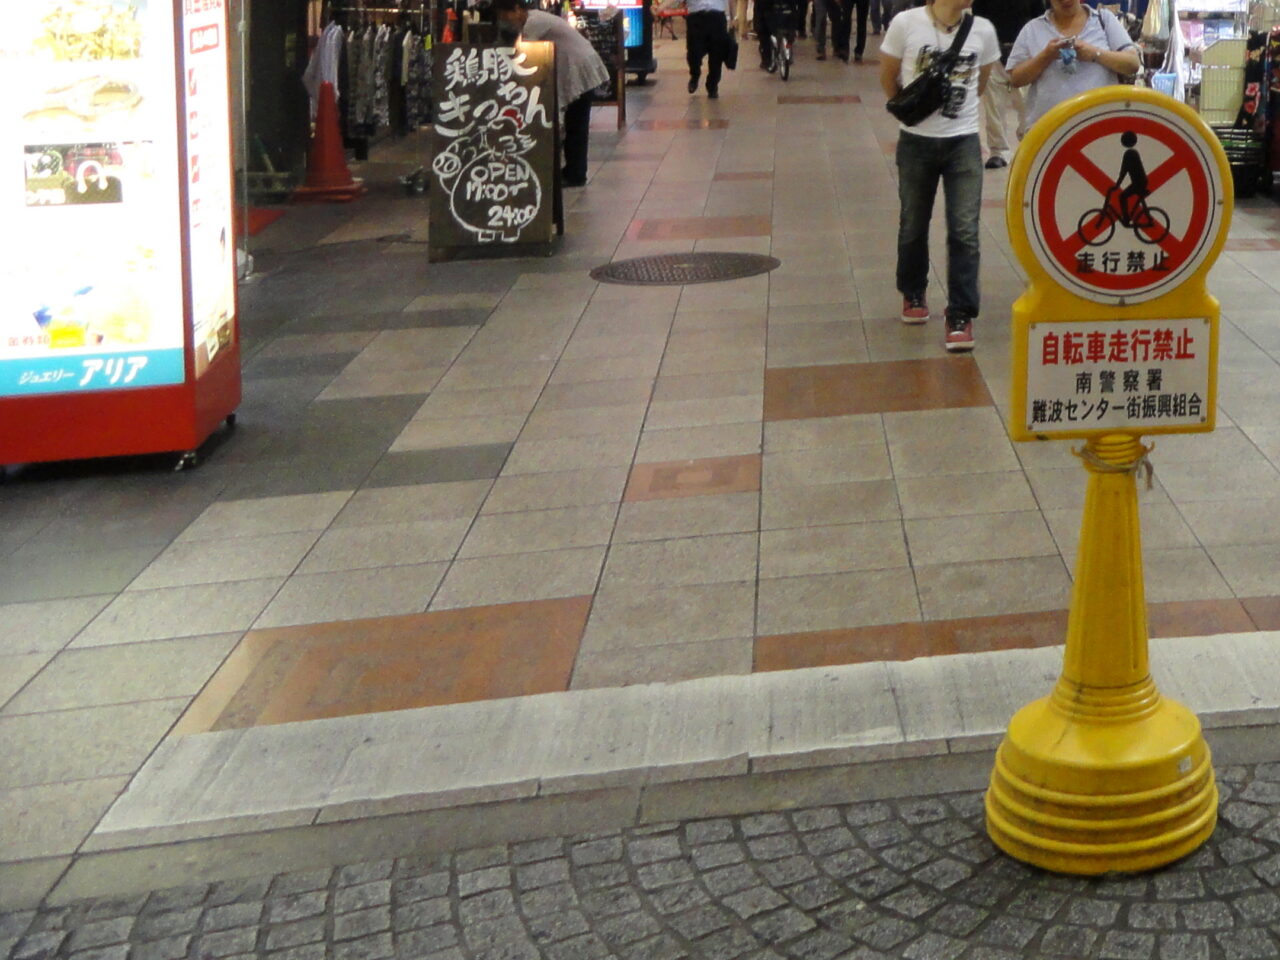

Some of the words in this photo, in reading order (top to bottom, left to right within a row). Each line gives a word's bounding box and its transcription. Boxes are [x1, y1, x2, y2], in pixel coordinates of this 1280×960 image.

[434, 81, 552, 137] きっちん
[471, 162, 531, 182] OPEN
[488, 204, 537, 228] 24:00
[1076, 251, 1171, 274] 走行禁止
[1042, 327, 1196, 367] 自転車走行禁止
[18, 369, 75, 385] ジュエリー
[79, 355, 148, 386] アリア
[1075, 368, 1163, 394] 南警察署
[1031, 393, 1203, 425] 難波センター街振興組合
